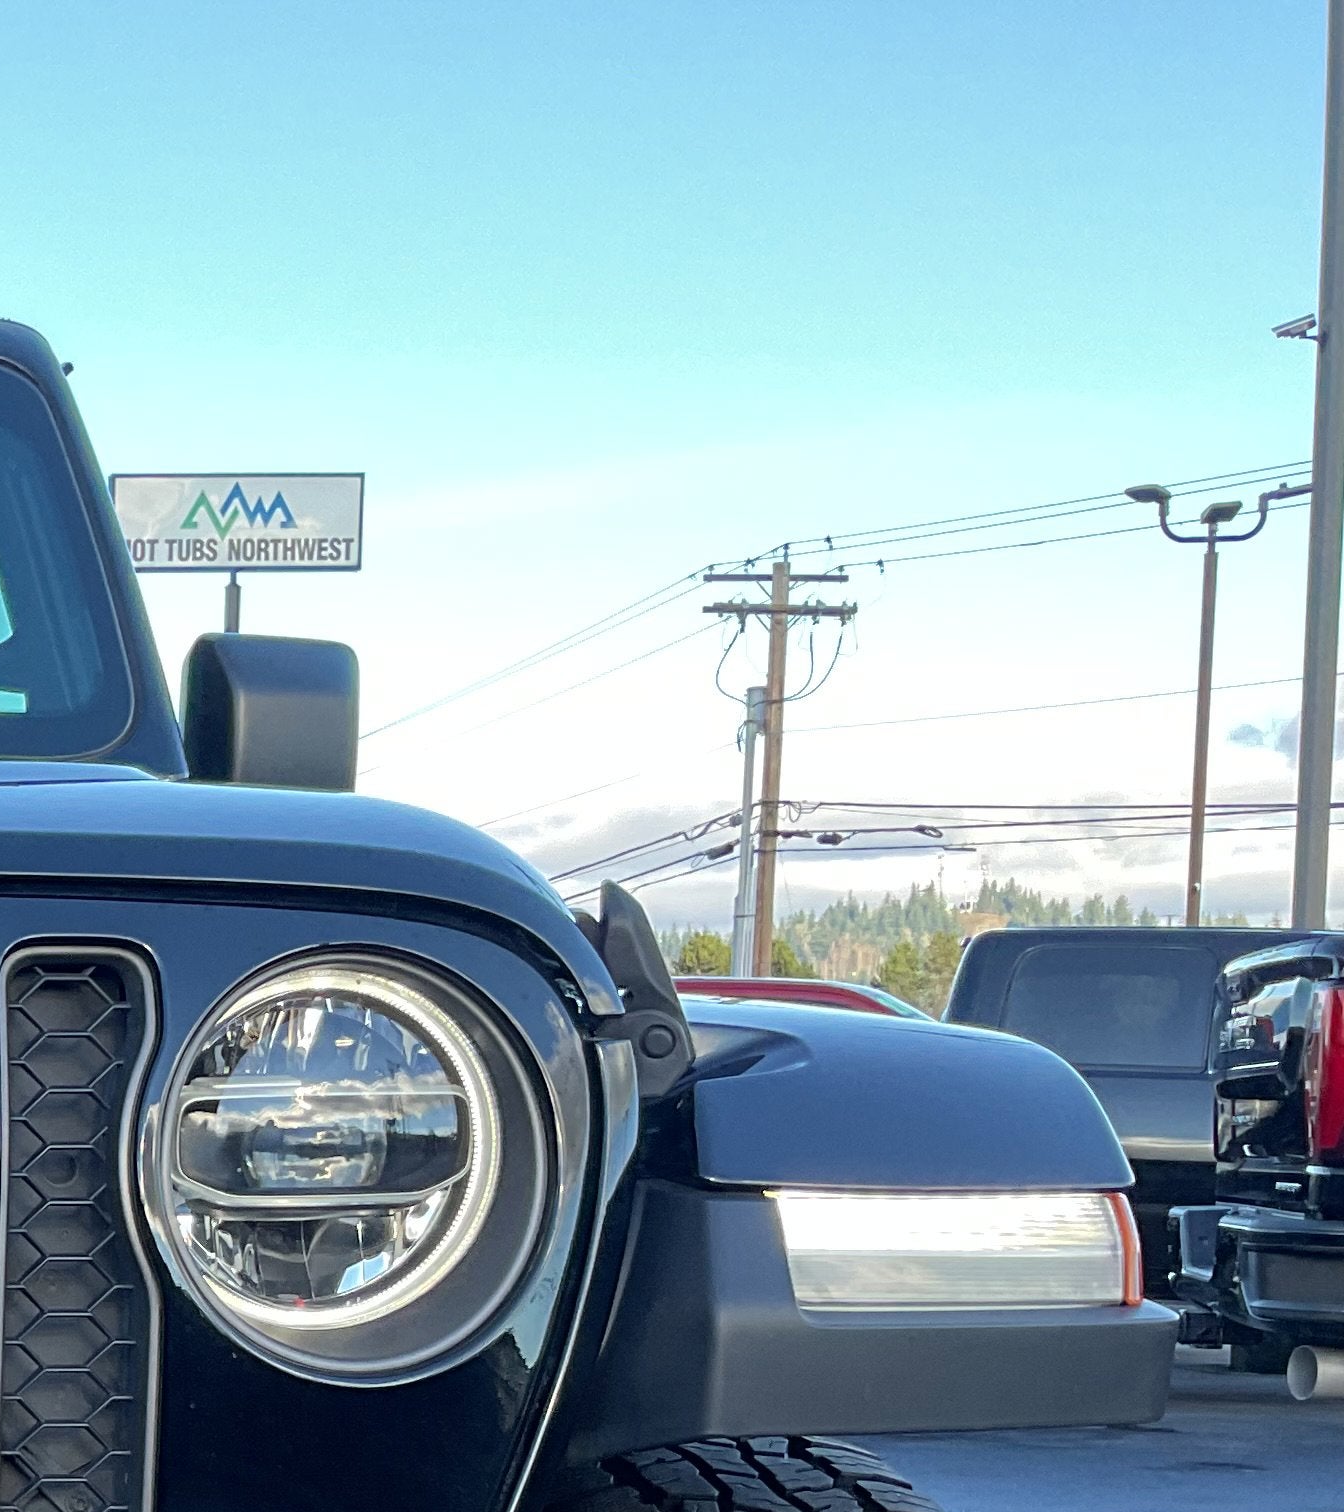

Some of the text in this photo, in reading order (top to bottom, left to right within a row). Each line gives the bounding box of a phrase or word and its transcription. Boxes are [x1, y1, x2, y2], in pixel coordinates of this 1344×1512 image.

[127, 537, 355, 562] OT TUBS NORTHWEST
